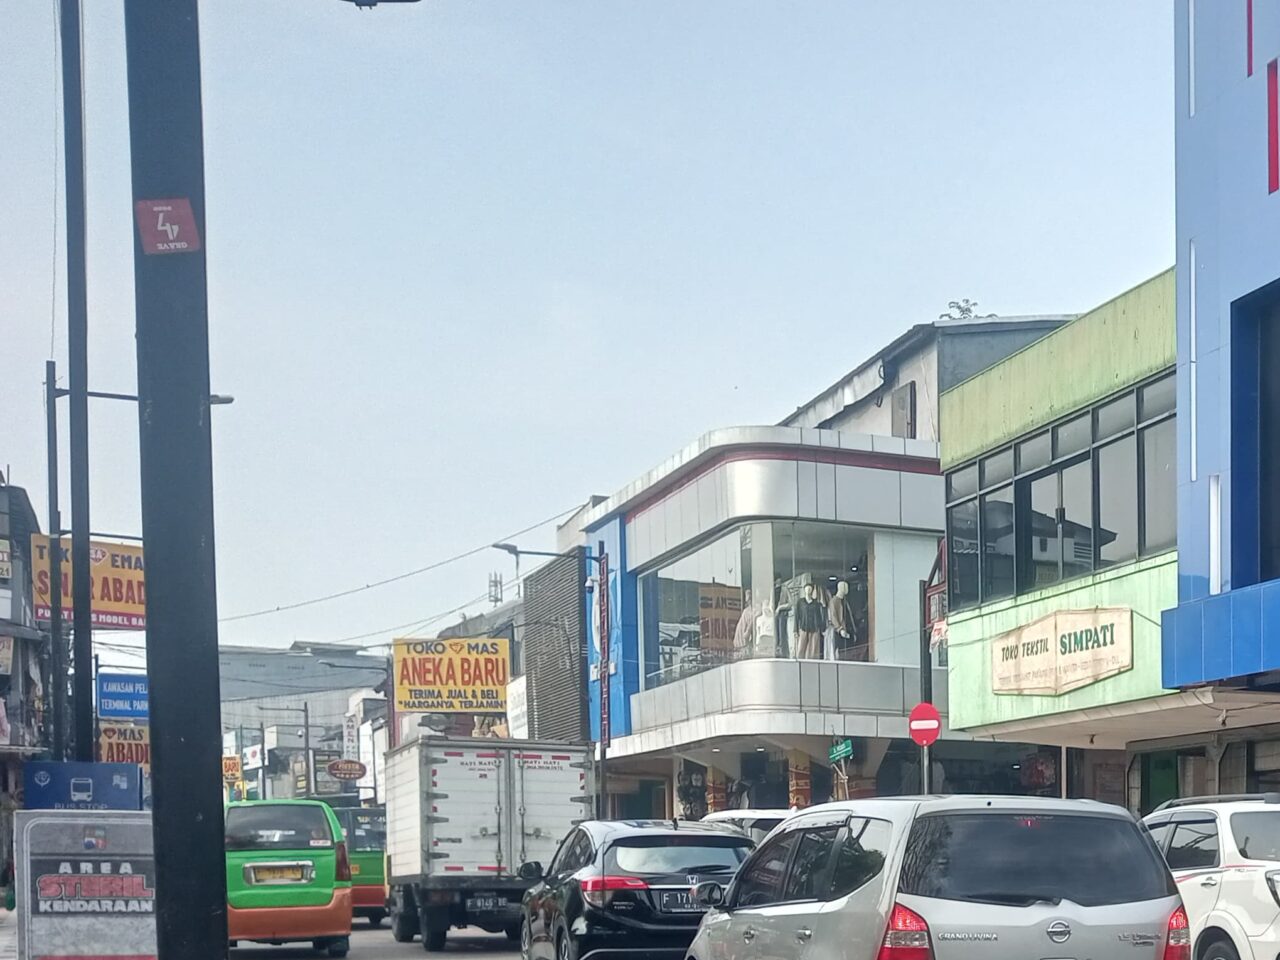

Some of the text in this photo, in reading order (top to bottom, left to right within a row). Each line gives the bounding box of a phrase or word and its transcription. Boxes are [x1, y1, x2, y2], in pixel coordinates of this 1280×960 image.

[111, 553, 144, 570] EMA
[100, 576, 145, 605] ABAD
[100, 614, 129, 625] MODEL
[406, 642, 499, 655] TOKO MAS
[1001, 622, 1115, 662] TOKO TEKSTIL SIMPATI
[400, 657, 507, 687] ANEKA BARU
[408, 688, 499, 700] TERIMA JUAL & BELI
[116, 728, 145, 741] MAS
[58, 861, 134, 874] AREA
[37, 874, 155, 900] STERIL
[663, 892, 670, 904] F
[38, 900, 154, 913] KENDARAAN
